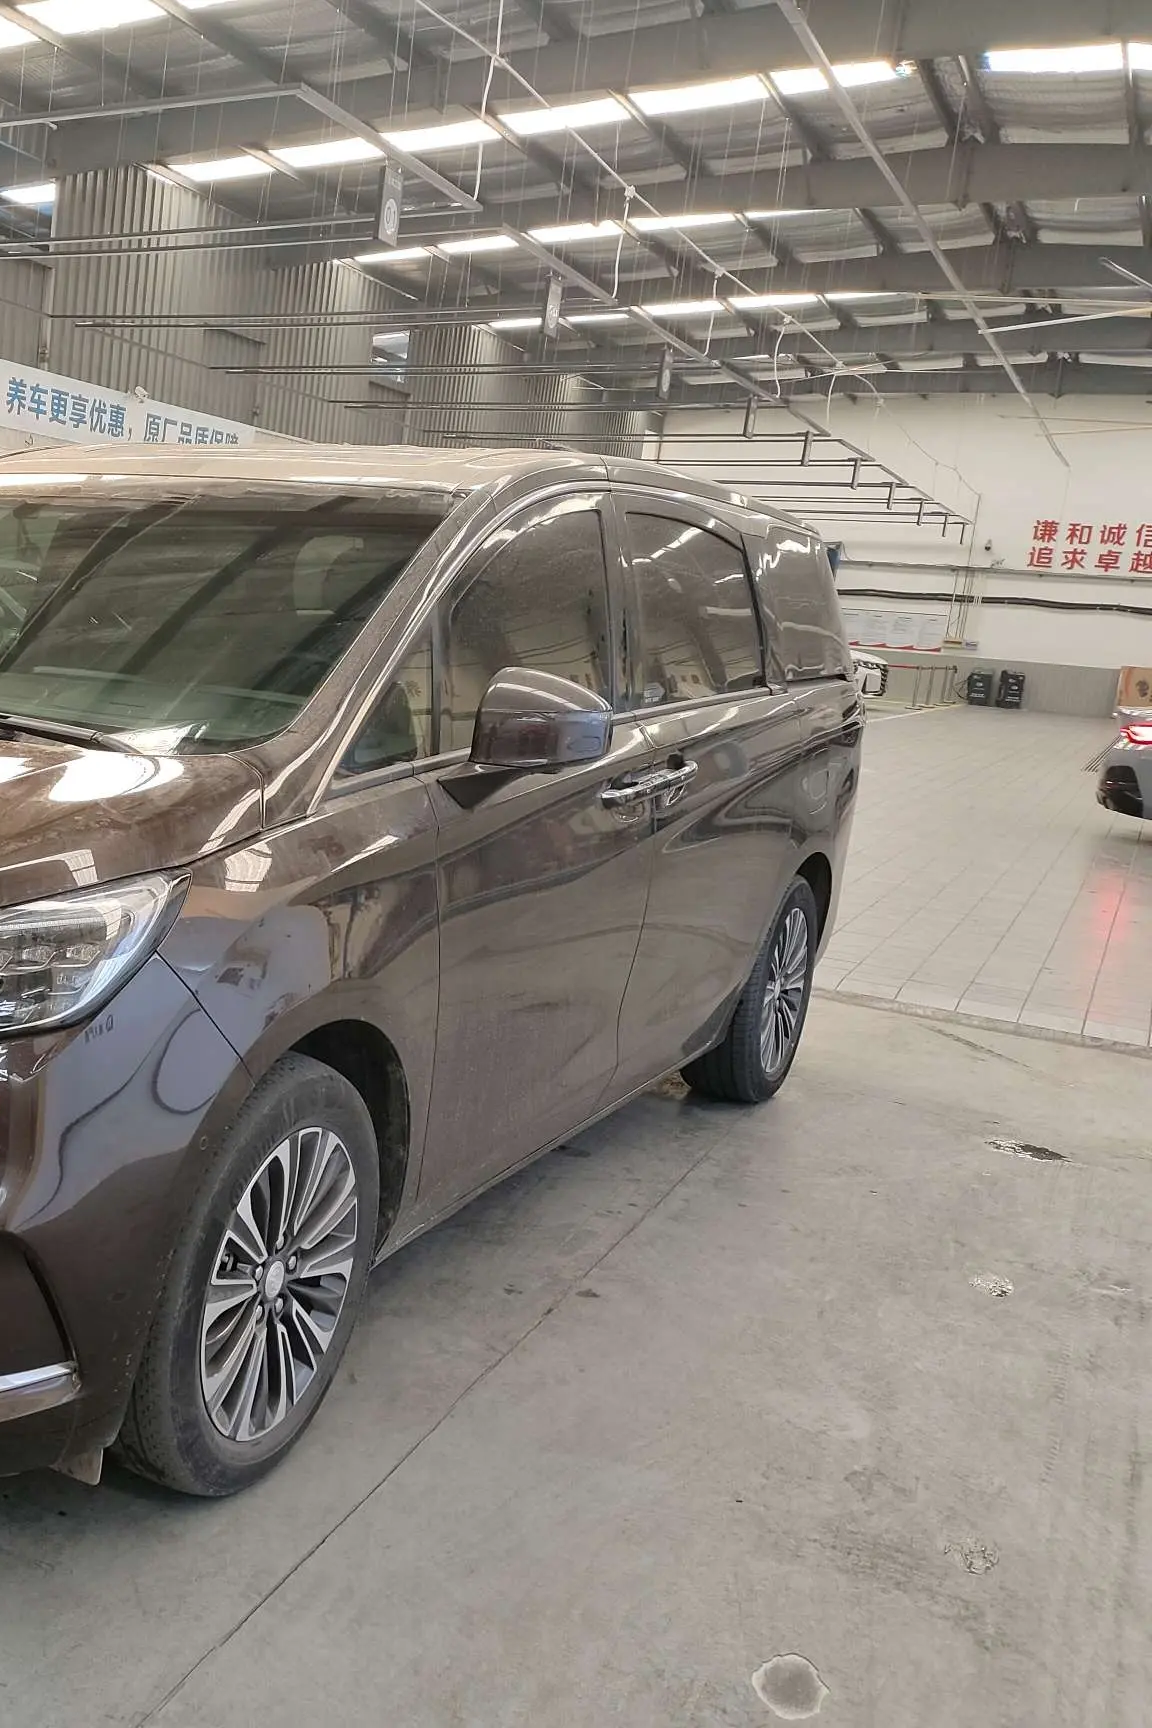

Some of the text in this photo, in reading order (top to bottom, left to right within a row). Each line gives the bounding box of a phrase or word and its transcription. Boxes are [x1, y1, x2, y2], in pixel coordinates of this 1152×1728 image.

[1032, 519, 1152, 548] 谦和诚信
[1027, 546, 1152, 574] 追求卓越
